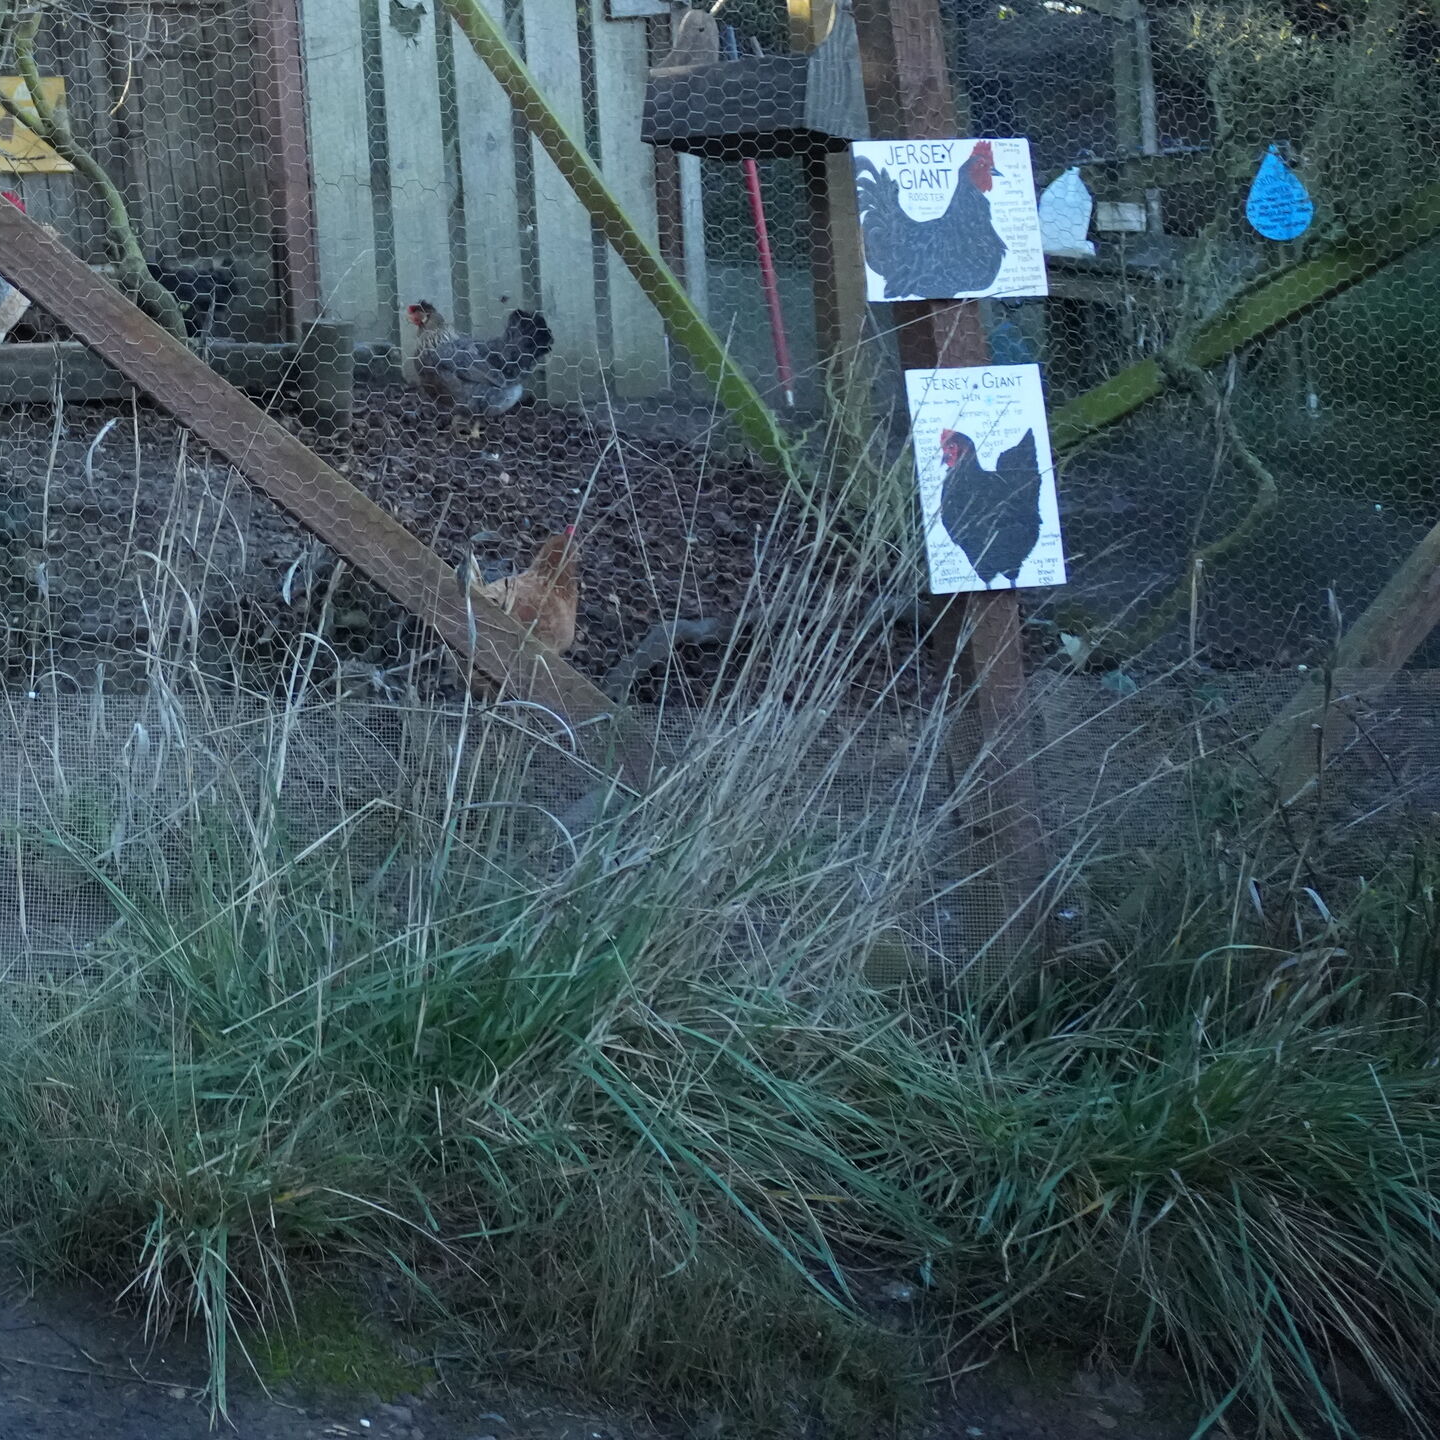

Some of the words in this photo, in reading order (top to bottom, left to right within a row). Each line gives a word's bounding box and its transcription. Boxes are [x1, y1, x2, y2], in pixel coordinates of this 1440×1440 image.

[885, 142, 955, 166] JERSEY
[898, 168, 953, 190] GIANT
[908, 192, 945, 202] ROOSTER
[919, 375, 969, 392] JERSEY
[981, 372, 1023, 389] GIANT
[962, 393, 981, 402] HEN
